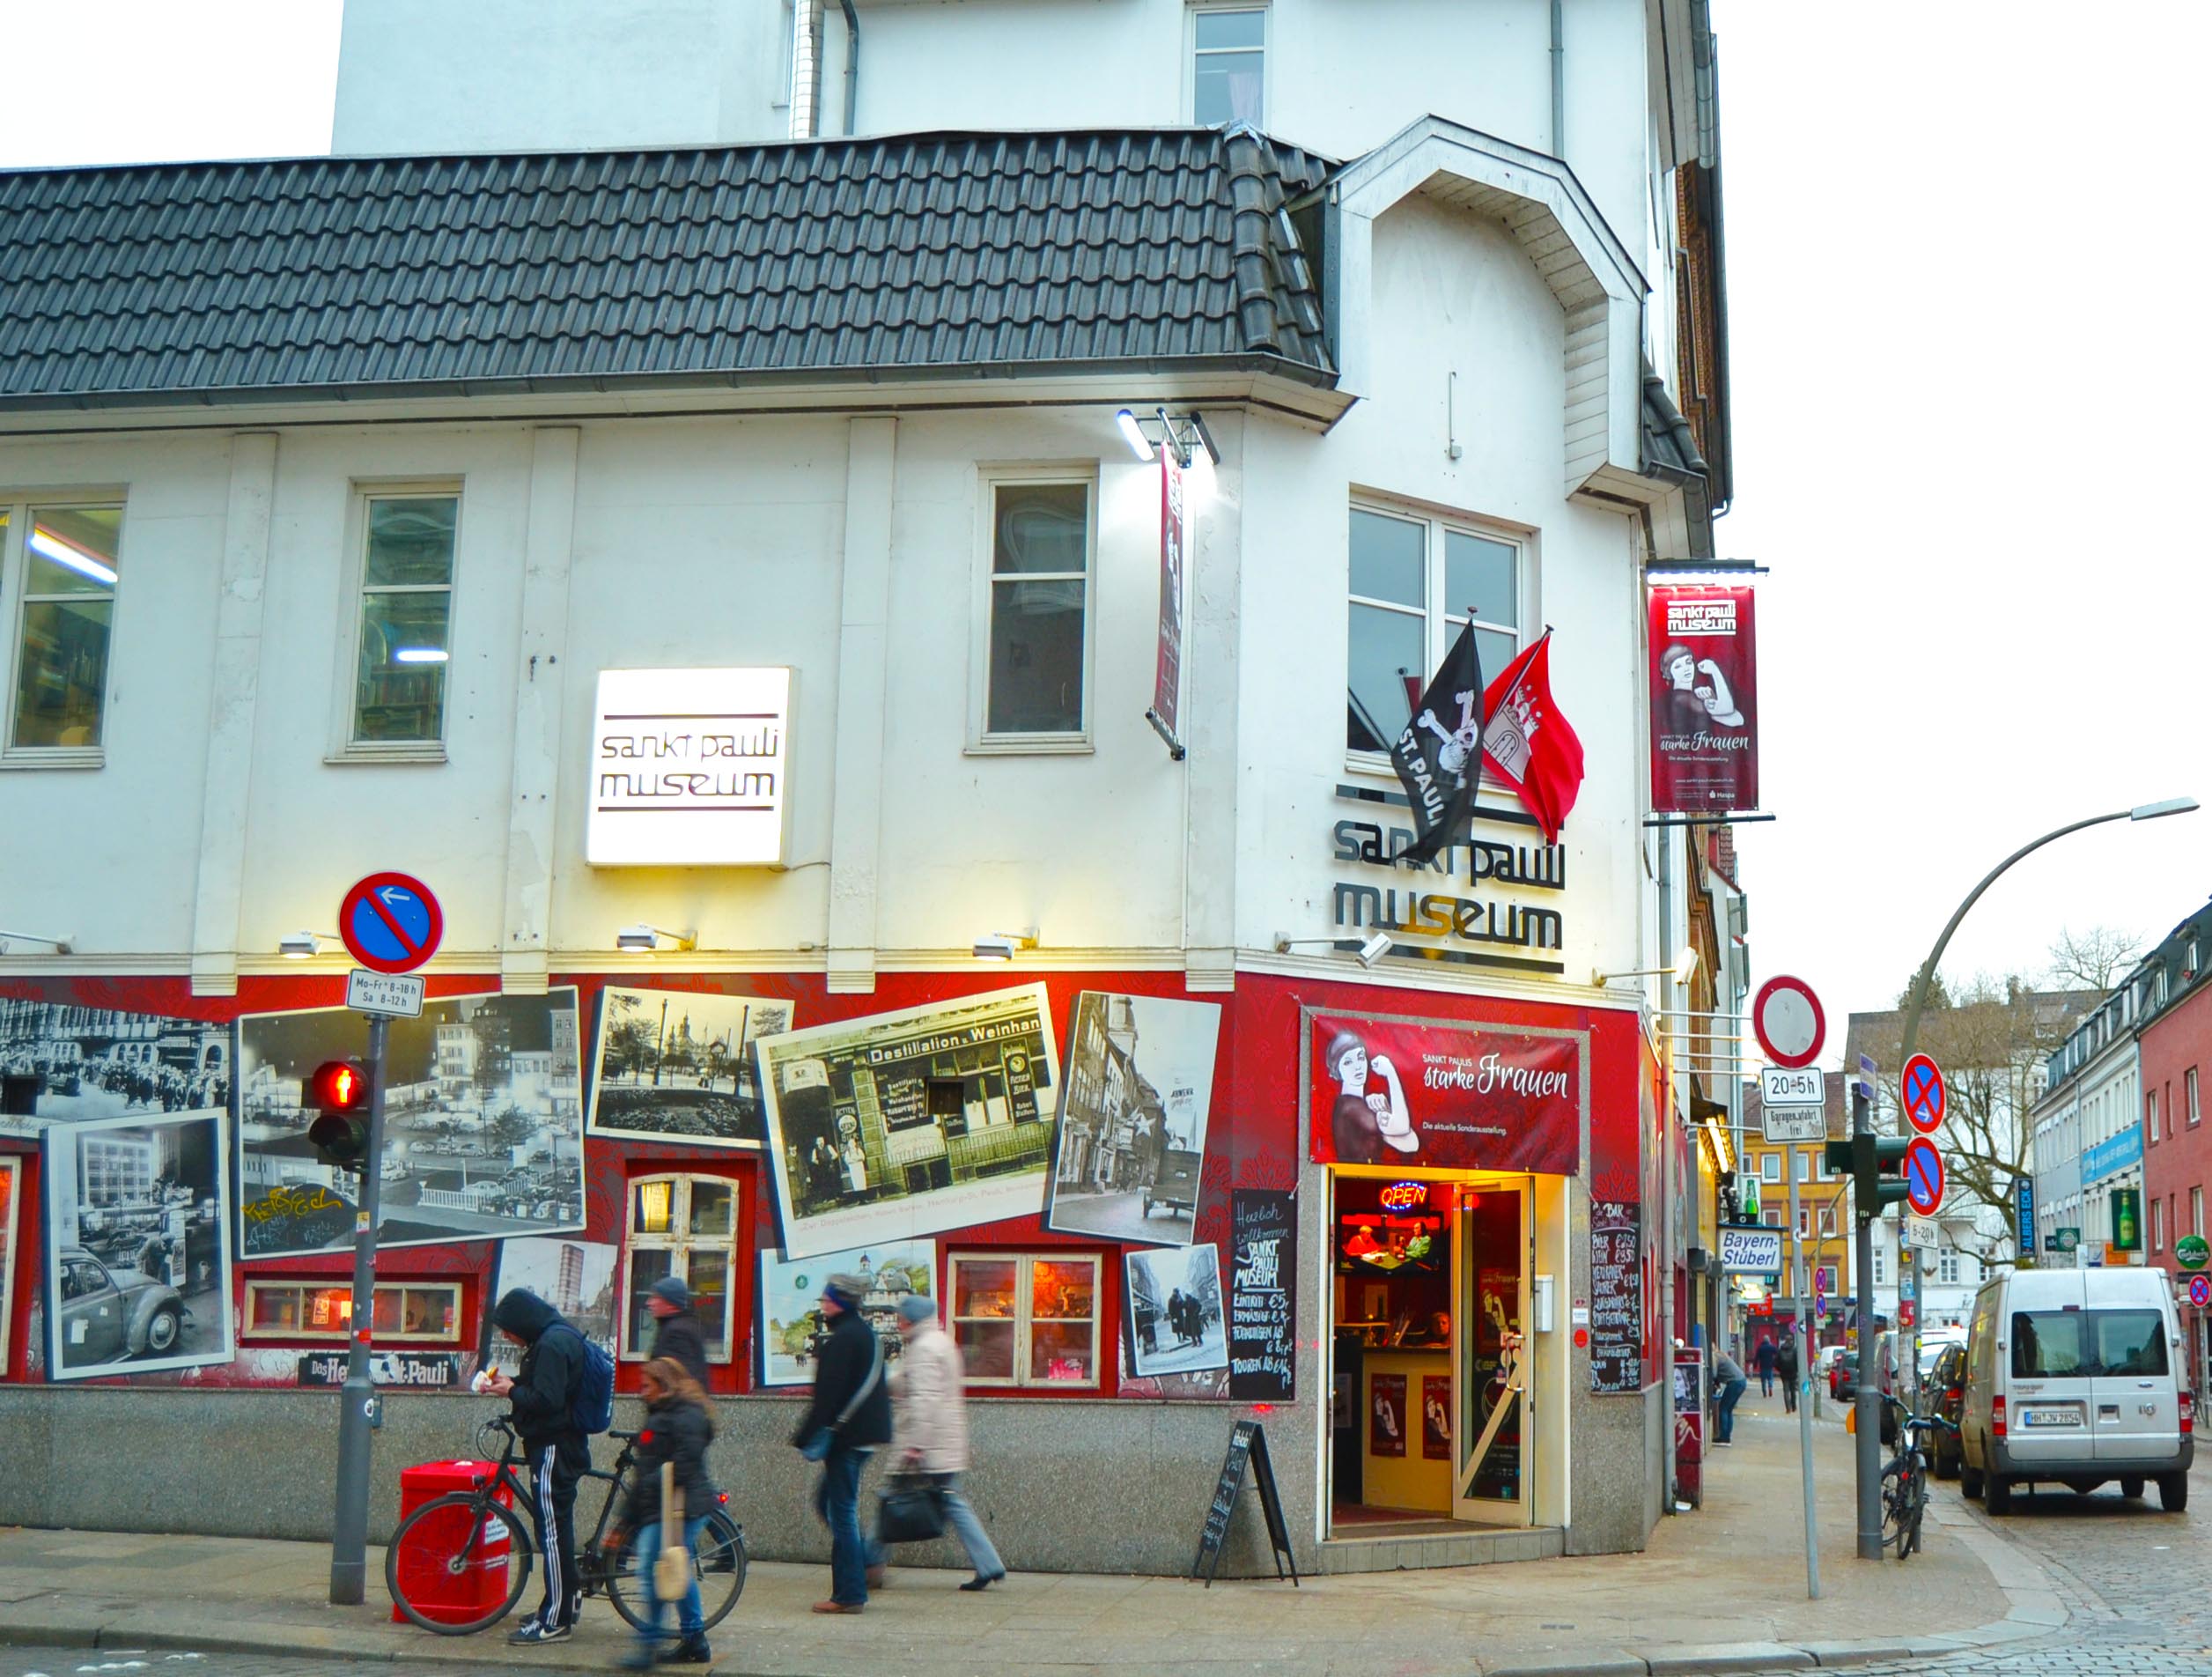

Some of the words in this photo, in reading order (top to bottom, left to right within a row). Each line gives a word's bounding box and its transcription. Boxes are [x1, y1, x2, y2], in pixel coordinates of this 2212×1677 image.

[1668, 606, 1704, 619] sankt
[1668, 618, 1736, 631] museum
[601, 732, 693, 758] sankt
[701, 727, 778, 763] pauli
[1398, 728, 1419, 760] ST.
[1660, 740, 1690, 750] starke
[1691, 730, 1749, 751] Frauen
[600, 772, 775, 797] museum
[1408, 757, 1447, 827] PAULI
[1333, 820, 1454, 875] san
[1333, 883, 1563, 950] museum
[356, 977, 382, 990] Mo-Fr
[363, 992, 373, 1002] Sa
[870, 1035, 960, 1063] Destillation
[970, 1018, 1041, 1042] Weinhan
[1422, 1053, 1447, 1064] SANKT
[1449, 1057, 1473, 1067] PAULIS
[1423, 1066, 1475, 1090] starke
[1477, 1053, 1567, 1098] Frauen
[1422, 1121, 1434, 1130] Die
[1434, 1122, 1456, 1132] aktuelle
[1770, 1110, 1818, 1124] Garagenufahrt
[1789, 1125, 1803, 1135] frei
[1381, 1186, 1427, 1205] OPEN
[2021, 1190, 2032, 1209] ECK
[1603, 1203, 1624, 1218] BAR
[2021, 1210, 2033, 1248] ALBERS
[1723, 1231, 1778, 1251] Bayern-
[1235, 1239, 1280, 1263] SANKT
[1722, 1249, 1776, 1266] Stüberl
[2177, 1248, 2208, 1261] Carlsberg
[1252, 1254, 1279, 1273] PAULI
[1234, 1268, 1278, 1289] MUSEUM
[312, 1360, 328, 1376] Das
[327, 1358, 350, 1383] He
[1231, 1356, 1262, 1375] TOUREN
